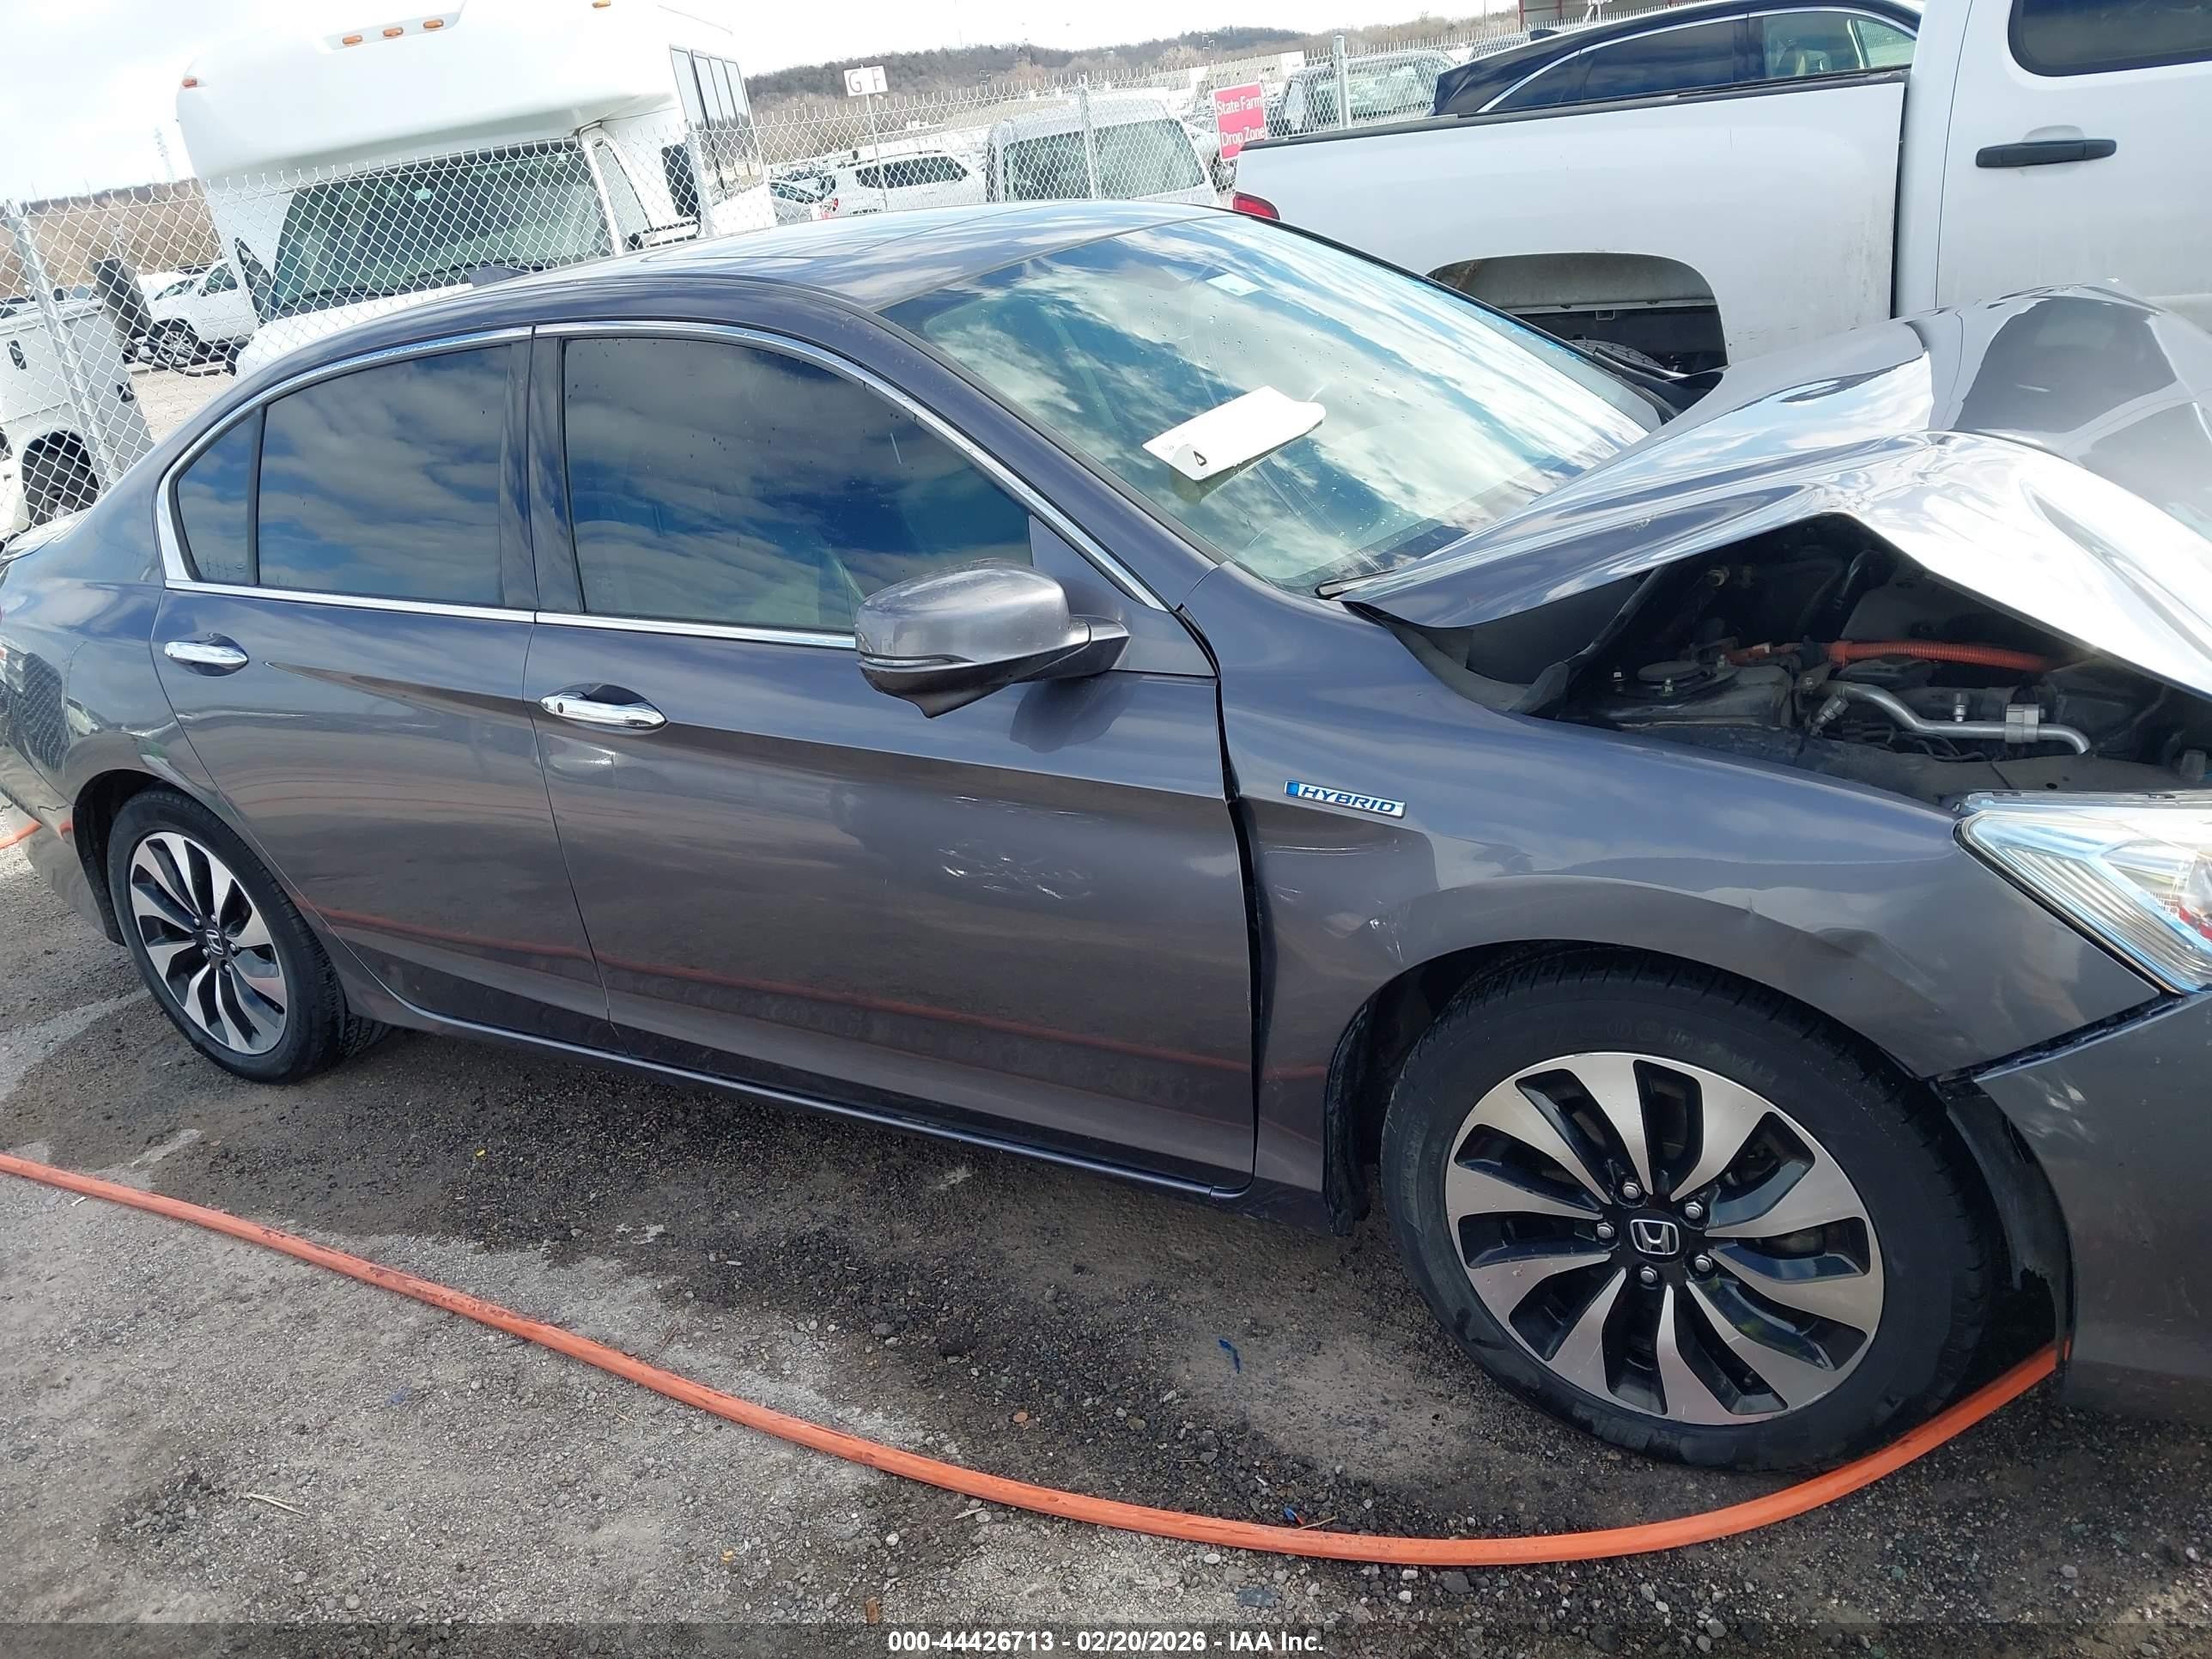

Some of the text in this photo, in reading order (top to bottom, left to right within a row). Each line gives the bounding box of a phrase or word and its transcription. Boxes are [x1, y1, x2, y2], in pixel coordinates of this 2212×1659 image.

[1216, 95, 1262, 116] State Farm
[1221, 125, 1265, 147] Drop Zone
[1301, 786, 1396, 812] HYBRID
